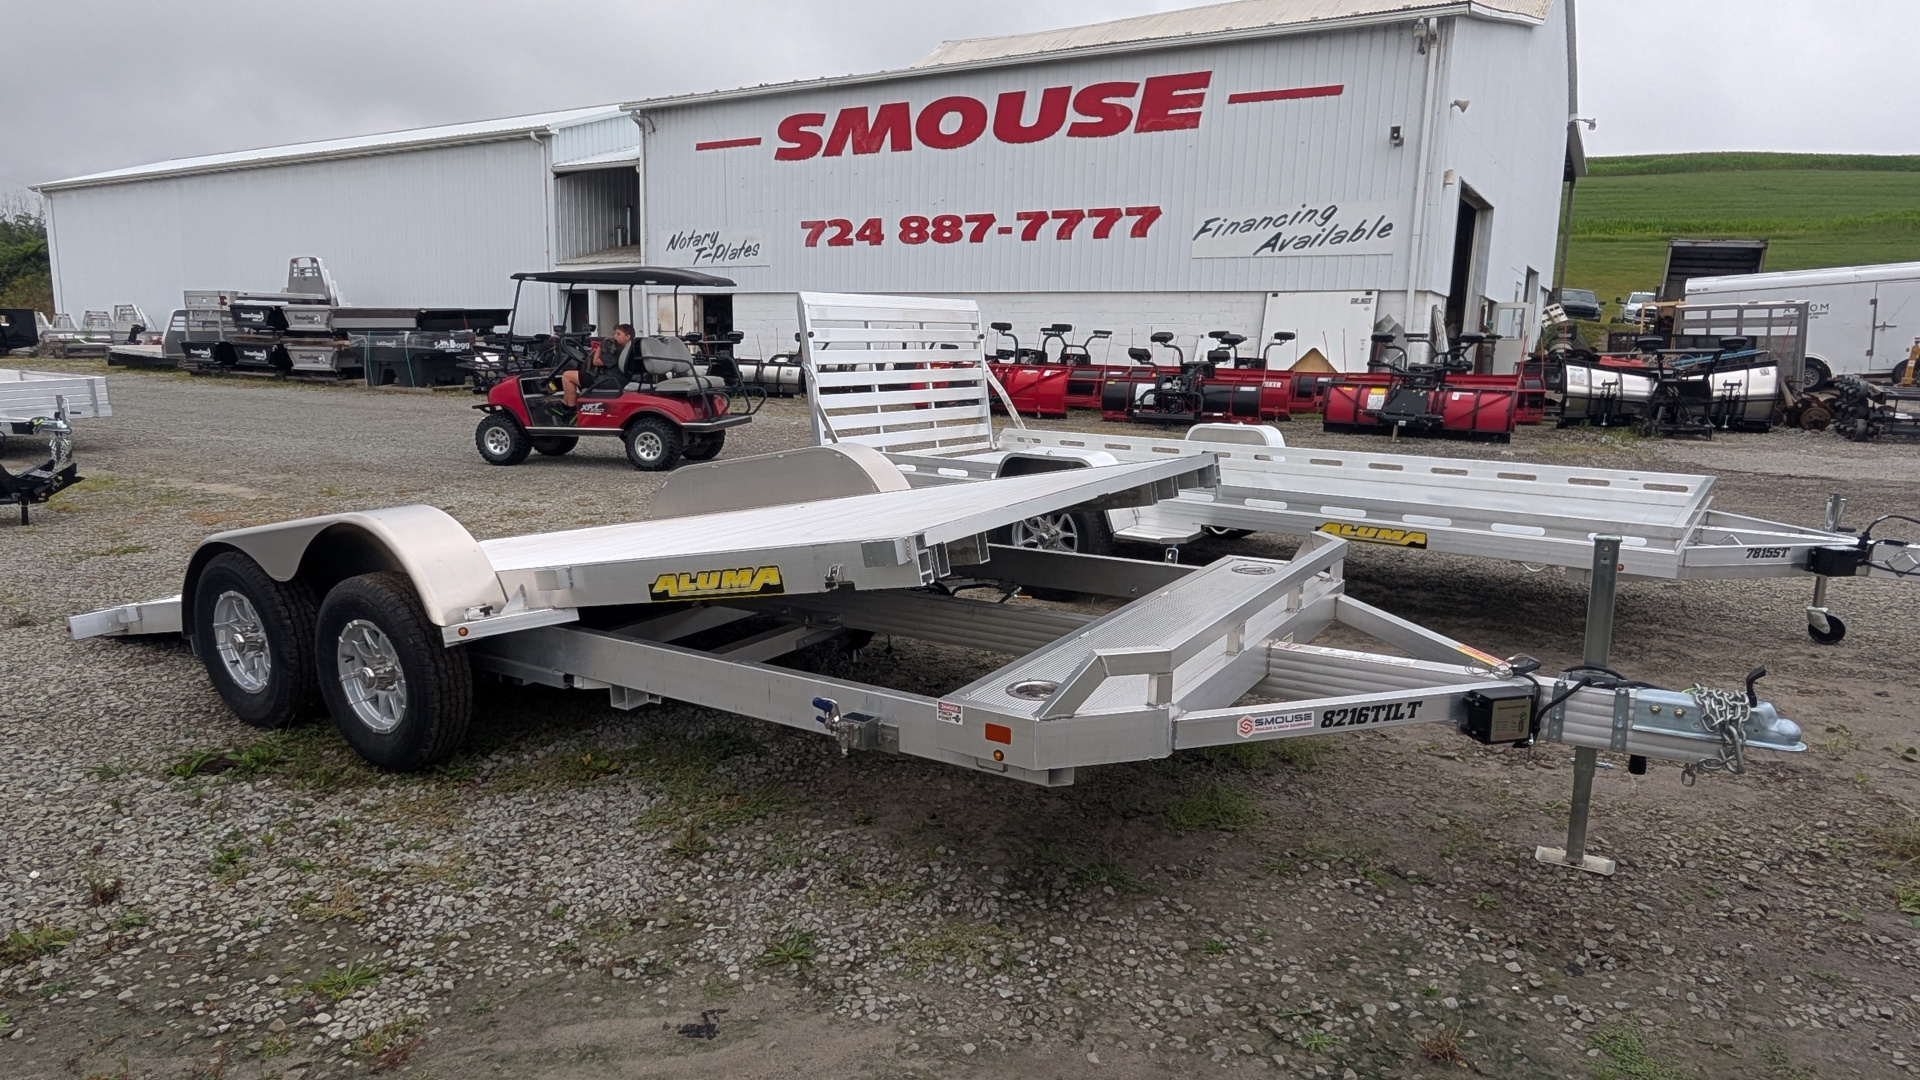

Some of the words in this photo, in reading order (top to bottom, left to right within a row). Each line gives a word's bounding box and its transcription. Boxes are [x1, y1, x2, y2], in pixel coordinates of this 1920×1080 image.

[774, 70, 1213, 161] SMOUSE
[800, 217, 884, 248] 724
[898, 205, 1162, 246] 887-7777
[1193, 203, 1338, 241] Financing
[1253, 215, 1394, 256] Available
[666, 229, 720, 252] Notary
[693, 243, 760, 265] T-Plates
[1319, 522, 1427, 546] ALUMA
[1746, 547, 1791, 559] 7815ST
[651, 566, 781, 598] ALUMA
[1254, 713, 1313, 727] SMOUSE
[1320, 701, 1423, 728] 8216TILT
